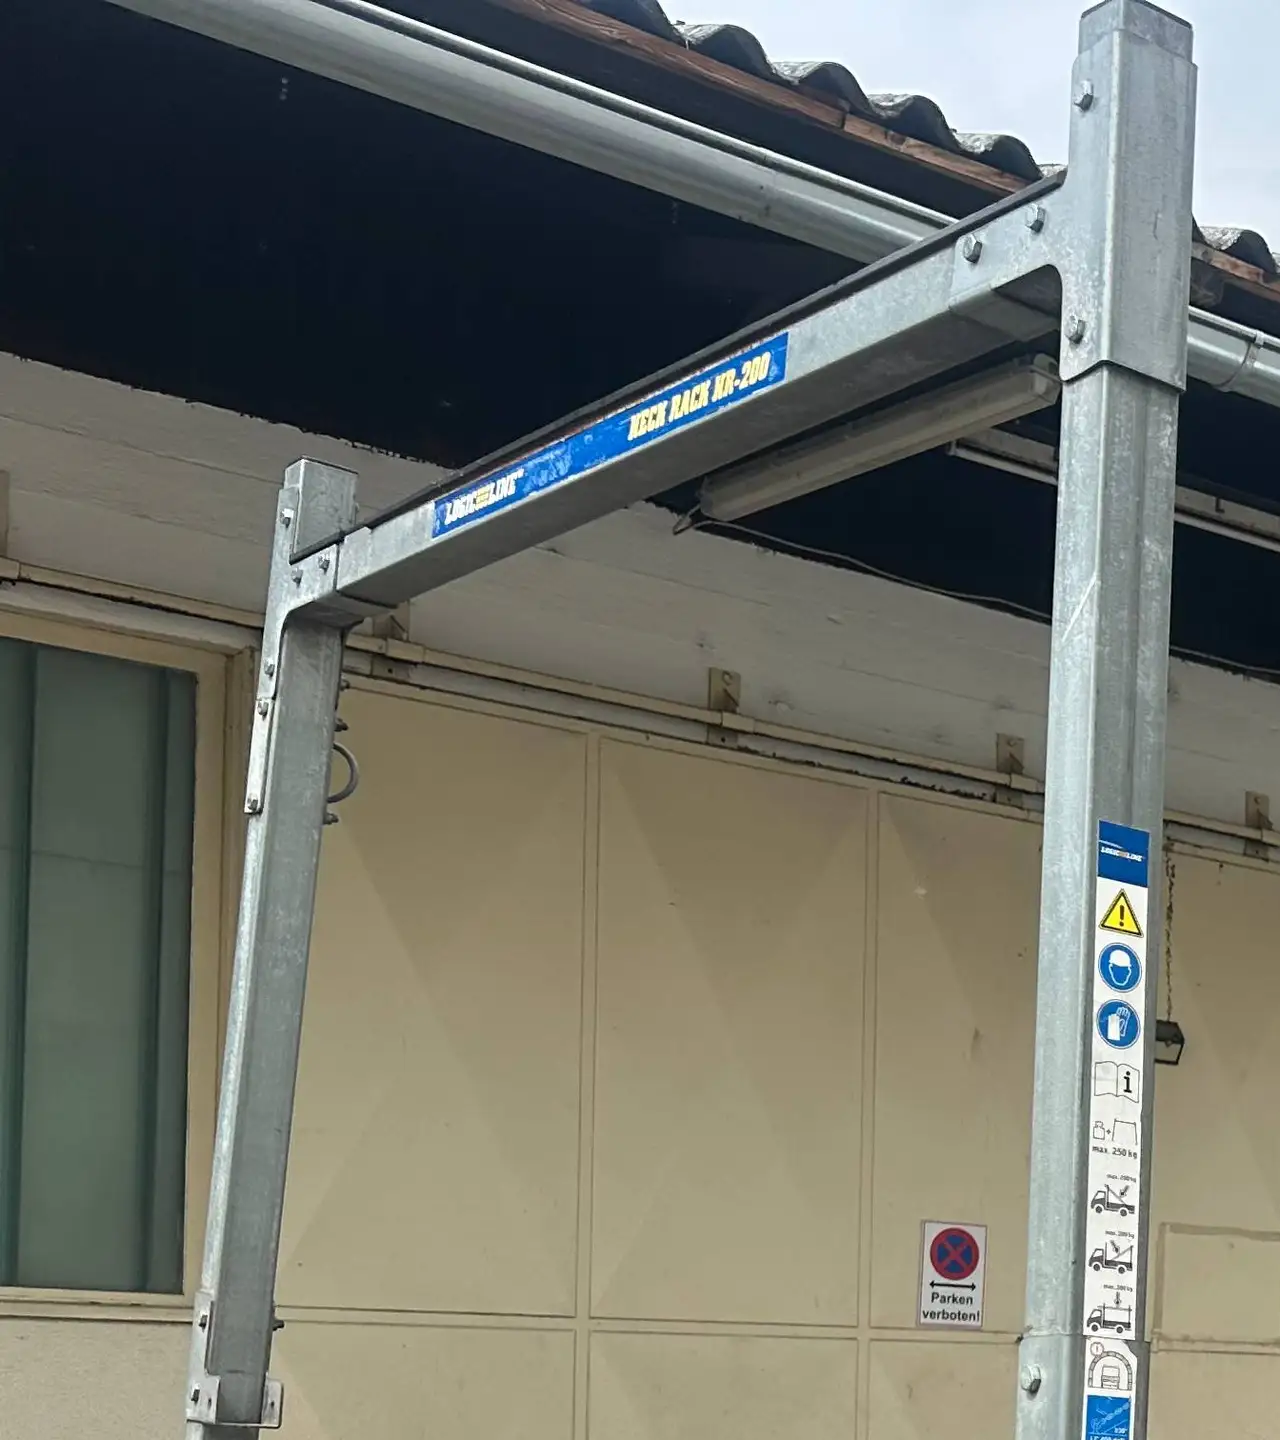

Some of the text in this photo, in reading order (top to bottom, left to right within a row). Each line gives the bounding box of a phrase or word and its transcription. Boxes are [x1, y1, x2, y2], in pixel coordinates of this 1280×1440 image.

[627, 400, 668, 441] NECK
[668, 379, 711, 422] RACK
[1112, 1146, 1127, 1157] 250
[1128, 1149, 1138, 1160] kg
[931, 1292, 973, 1305] Parken
[922, 1309, 980, 1322] verboten!
